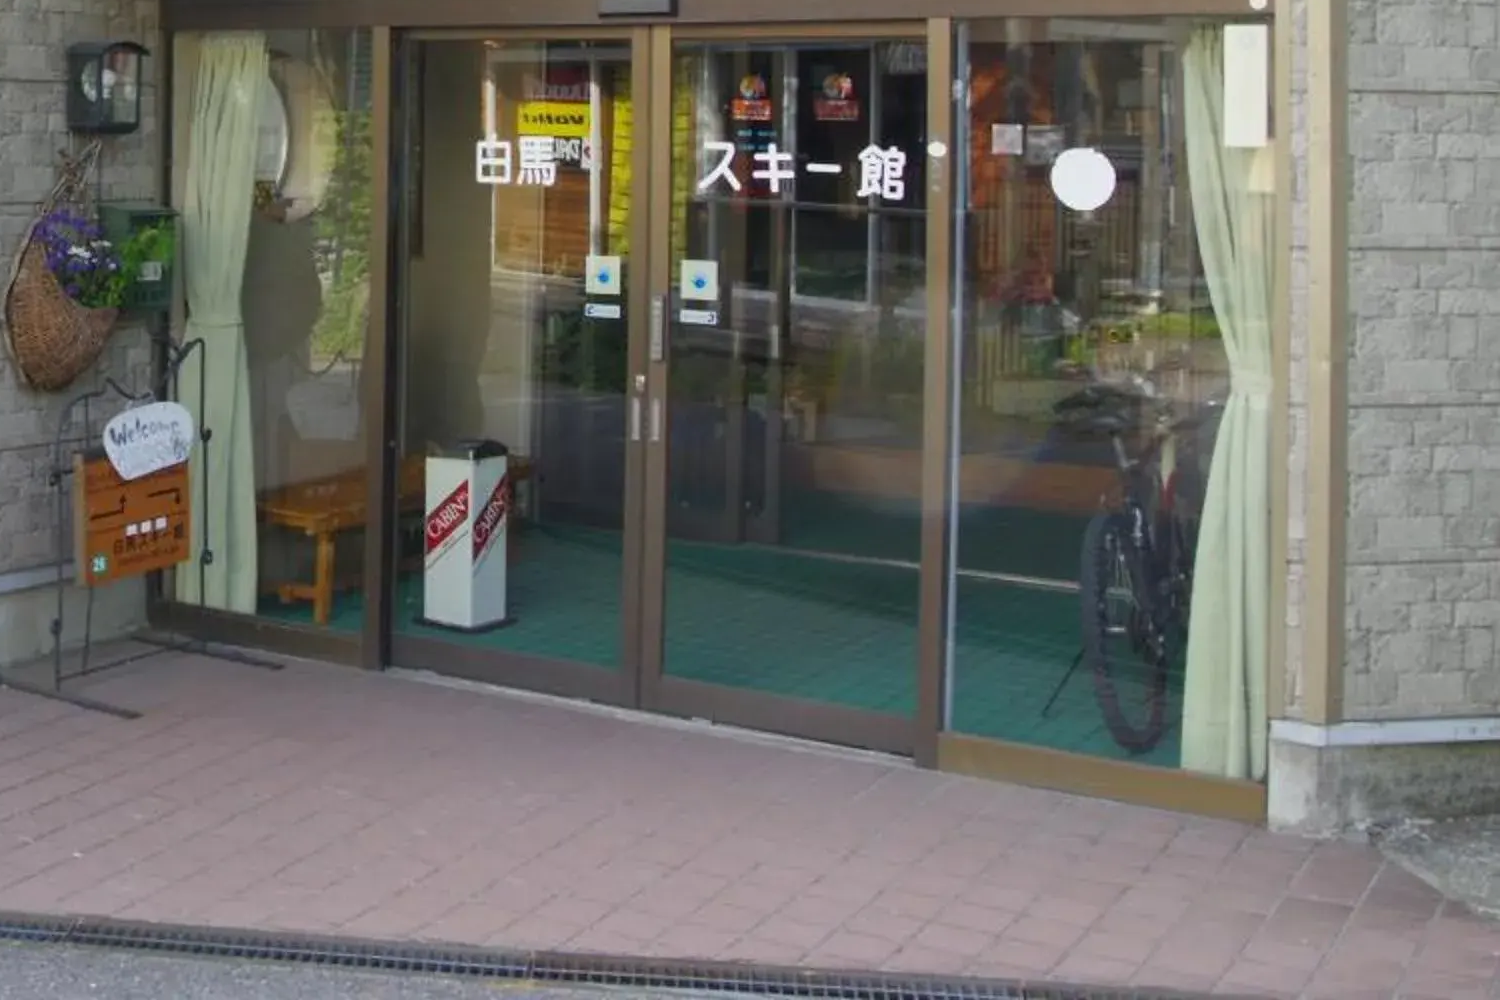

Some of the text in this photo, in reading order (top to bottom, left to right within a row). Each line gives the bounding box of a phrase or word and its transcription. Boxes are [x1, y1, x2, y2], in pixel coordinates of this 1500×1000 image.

[475, 134, 557, 187] 白馬
[698, 141, 907, 201] スキー館
